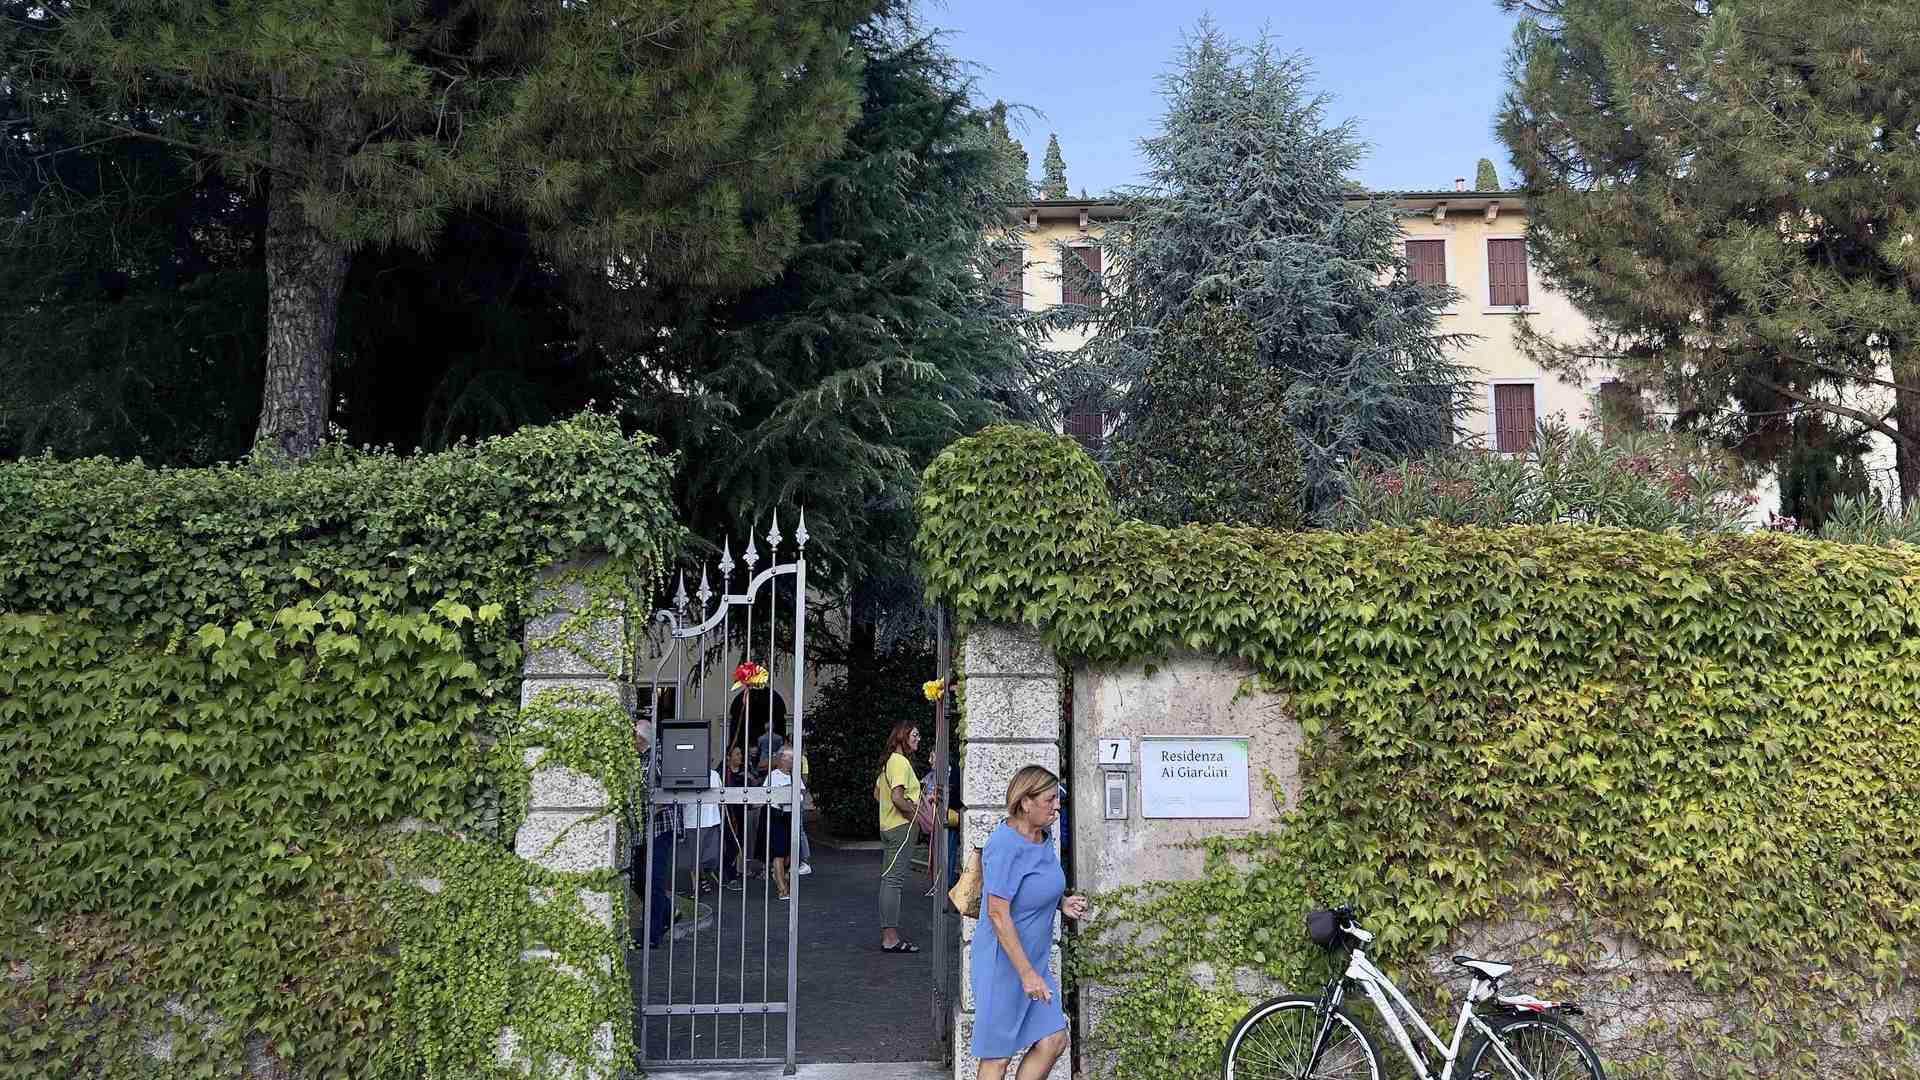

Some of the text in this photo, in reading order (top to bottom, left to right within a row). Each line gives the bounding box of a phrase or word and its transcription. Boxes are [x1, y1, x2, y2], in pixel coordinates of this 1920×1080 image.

[1110, 743, 1119, 760] 7
[1161, 750, 1224, 761] Residenza
[1161, 766, 1228, 778] Ai Giardini
